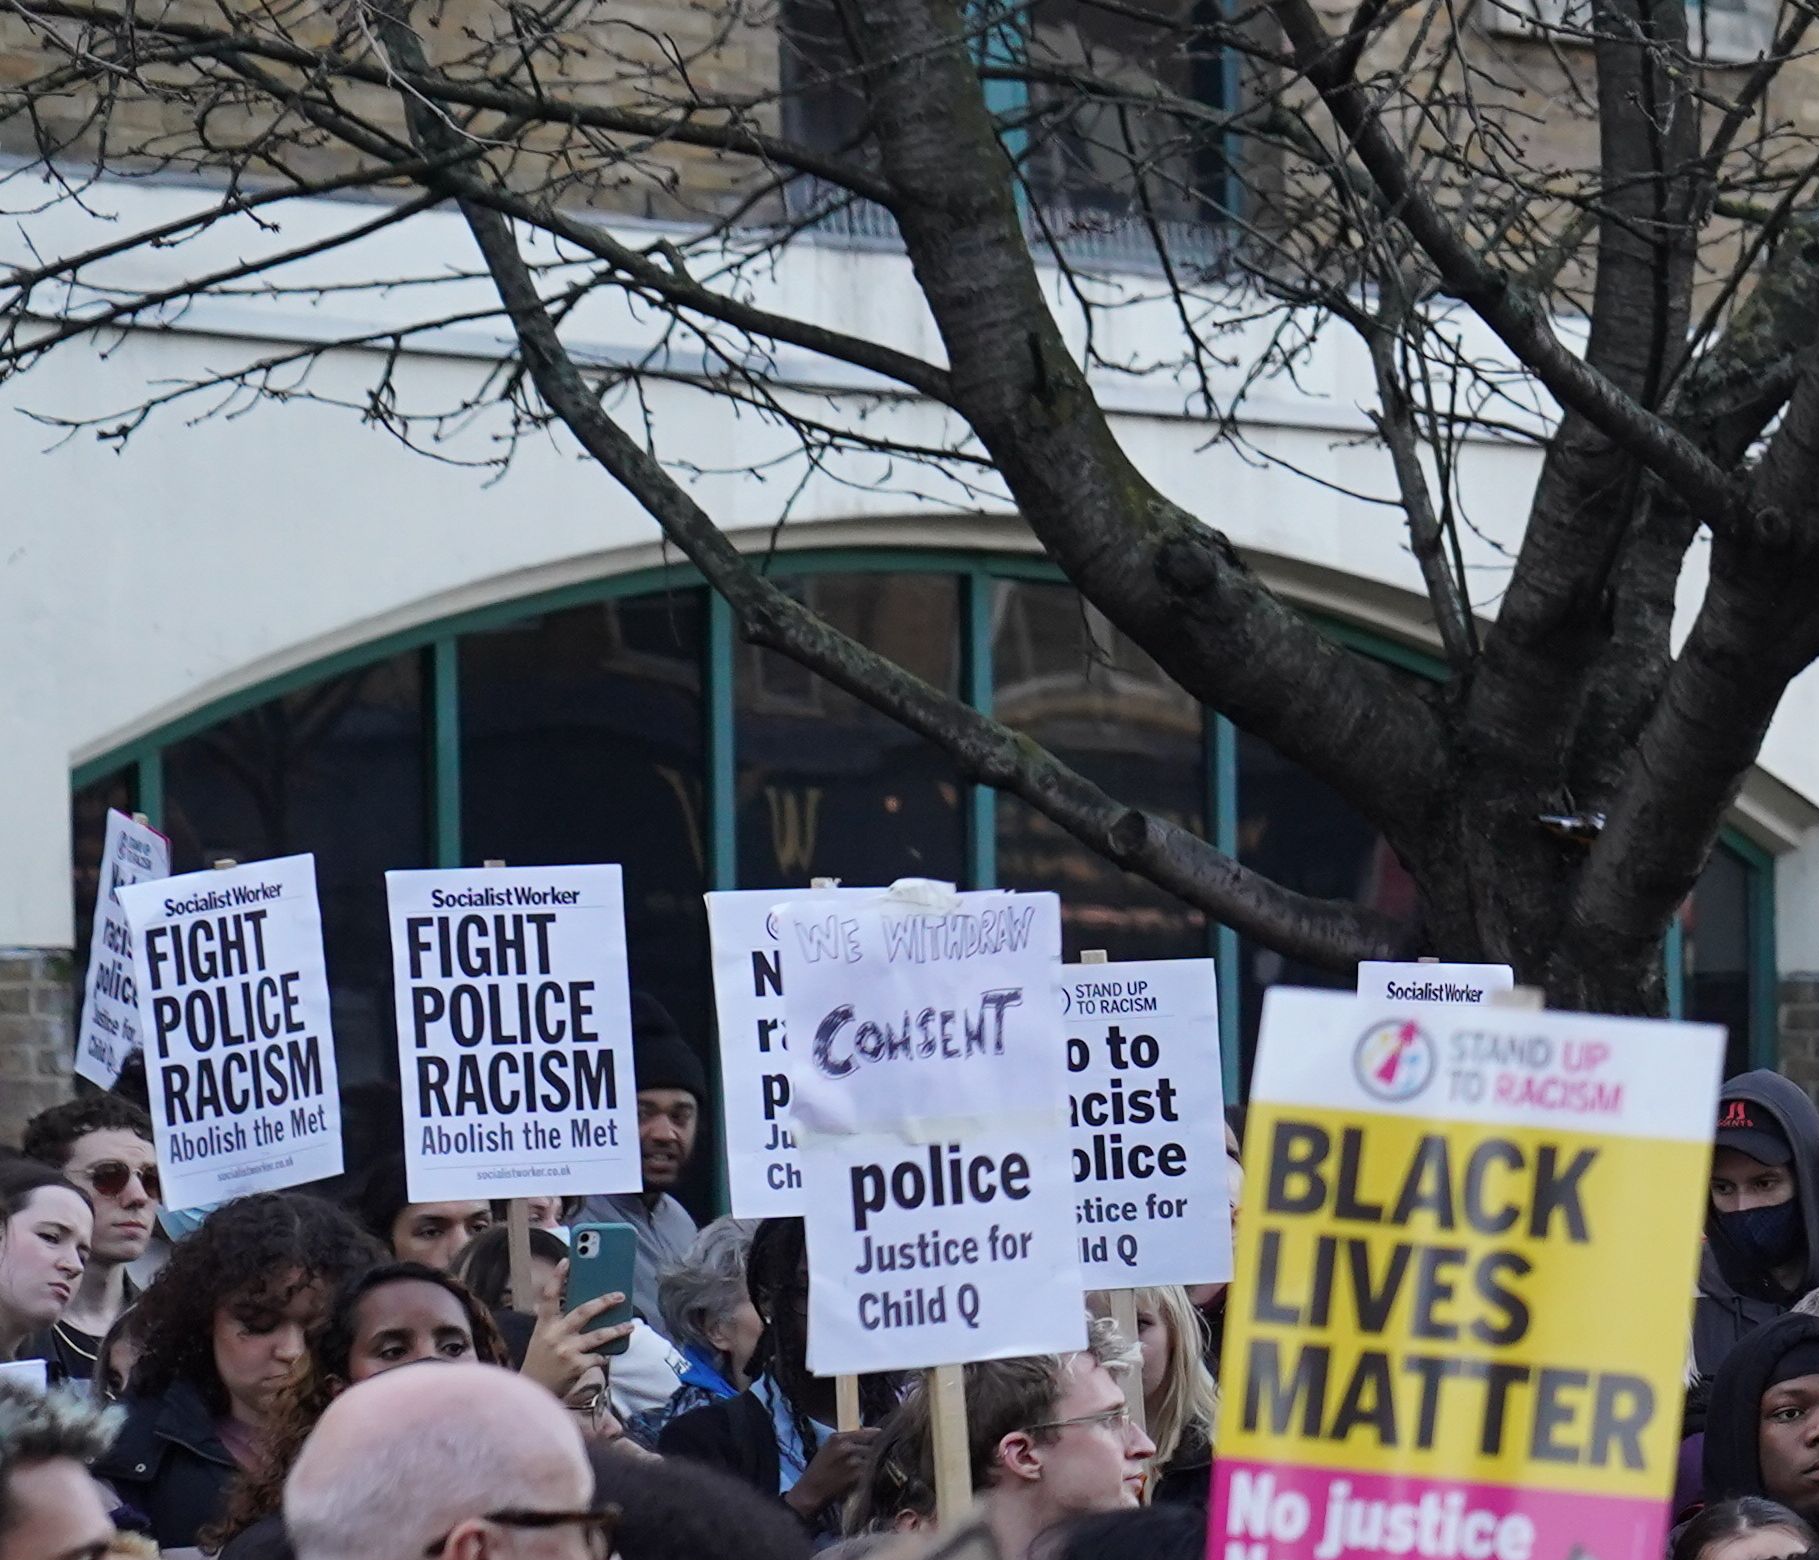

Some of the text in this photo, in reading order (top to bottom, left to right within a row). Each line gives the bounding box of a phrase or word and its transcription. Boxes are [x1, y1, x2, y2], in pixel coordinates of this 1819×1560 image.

[146, 909, 267, 990] FIGHT
[407, 913, 556, 979] FIGHT
[795, 905, 1036, 964] WE WITHDRAW
[153, 971, 305, 1059] POLICE
[412, 981, 598, 1048] POLICE
[1076, 981, 1147, 998] STAND UP
[1077, 997, 1156, 1014] TO RACISM
[813, 988, 1022, 1075] CONSENT
[1106, 1026, 1159, 1069] to
[1448, 1030, 1609, 1074] STAND UP
[161, 1036, 323, 1126] RACISM
[417, 1049, 617, 1117] RACISM
[1449, 1065, 1623, 1113] TO RACISM
[171, 1105, 327, 1163] Abolish the Met
[422, 1119, 618, 1155] Abolish the Met
[1073, 1134, 1186, 1182] olice
[477, 1165, 571, 1180] socialistworker.co.uk
[851, 1144, 1030, 1231] police
[1265, 1120, 1597, 1242] BLACK
[1146, 1194, 1187, 1219] for
[855, 1230, 978, 1274] Justice
[989, 1225, 1032, 1261] for
[1117, 1235, 1137, 1266] Q
[859, 1284, 979, 1330] Child Q
[1255, 1230, 1534, 1348] LIVES
[1240, 1340, 1653, 1468] MATTER
[1226, 1469, 1311, 1543] No
